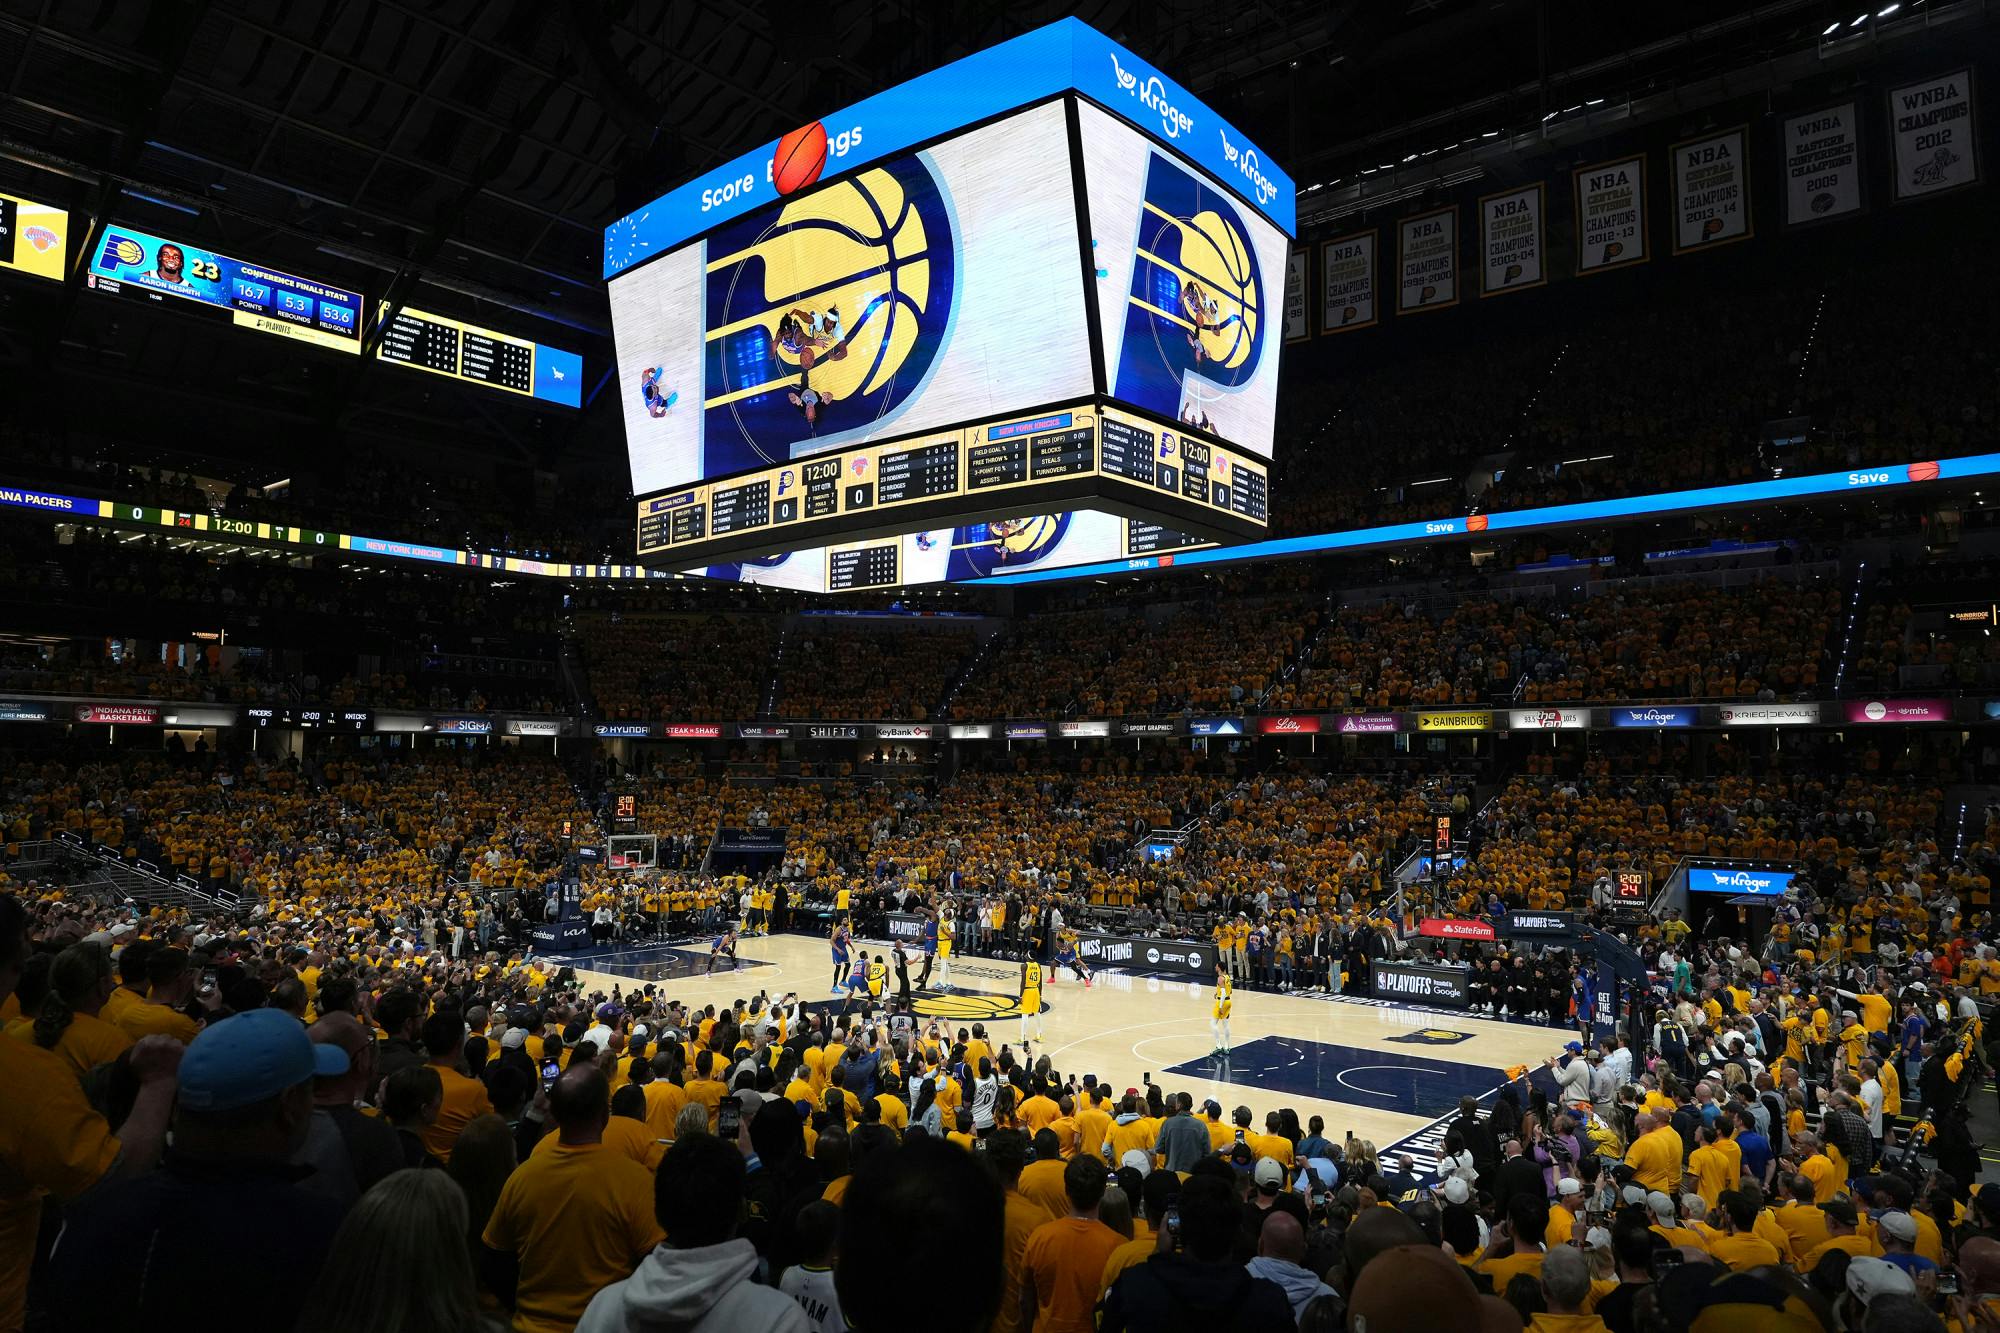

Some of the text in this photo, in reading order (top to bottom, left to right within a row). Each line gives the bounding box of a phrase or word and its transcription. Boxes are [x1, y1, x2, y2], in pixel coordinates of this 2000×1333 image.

[1902, 84, 1959, 111] WNBA
[1140, 77, 1194, 138] Kroger
[1898, 101, 1968, 133] CHAMPIONS
[1797, 116, 1841, 137] WNBA
[1796, 134, 1845, 155] EASTERN
[1916, 129, 1952, 151] 2012
[1688, 143, 1731, 168] NBA
[1788, 143, 1855, 167] CONFERENCE
[1686, 161, 1736, 182] CENTRAL
[1791, 154, 1852, 178] CHAMPIONS
[1240, 150, 1278, 206] Kroger
[1590, 170, 1630, 192] NBA
[1688, 171, 1734, 192] DIVISION
[1807, 174, 1839, 192] 2009
[701, 174, 754, 212] Score
[1587, 189, 1633, 205] CENTRAL
[1684, 185, 1738, 210] CHAMPIONS
[1494, 198, 1529, 220] NBA
[1589, 196, 1632, 216] DIVISION
[1490, 214, 1533, 231] CENTRAL
[1586, 210, 1636, 233] CHAMPIONS
[1413, 221, 1442, 240] NBA
[1490, 223, 1533, 241] DIVISION
[1489, 233, 1534, 256] CHAMPIONS
[1334, 244, 1363, 262] NBA
[190, 256, 220, 285] 23
[1405, 256, 1449, 279] CHAMPIONS
[139, 274, 201, 298] AARON NESMITH
[240, 265, 350, 303] CONFERENCE FINALS STATS
[1403, 270, 1453, 290] 1999-2000
[238, 282, 265, 302] 16.7
[1328, 278, 1370, 298] CHAMPIONS
[238, 299, 263, 312] POINTS
[285, 295, 306, 313] 5.3
[277, 309, 312, 325] REBOUNDS
[322, 306, 350, 325] 53.6
[265, 318, 292, 337] PLAYOFFS
[319, 320, 332, 330] FIELD
[332, 322, 347, 334] GOAL
[999, 417, 1061, 436] NEW YORK KNICKS
[974, 448, 988, 457] FIELD
[988, 447, 1002, 455] GOAL
[1040, 446, 1062, 455] BLOCKS
[1183, 440, 1209, 464] 12:00
[972, 458, 985, 467] FREE
[985, 455, 1003, 465] THROW
[1041, 456, 1061, 465] STEALS
[806, 461, 838, 483] 12:00
[880, 463, 909, 474] 11 BRUNSON
[1035, 465, 1067, 476] TURNOVERS
[879, 472, 911, 484] 23 ROBINSON
[979, 475, 1001, 485] ASSISTS
[1164, 470, 1171, 486] 0
[1848, 470, 1890, 486] Save
[811, 482, 832, 494] 1ST QTR
[879, 482, 907, 493] 25 BRIDGES
[24, 493, 73, 509] PACERS
[855, 488, 864, 504] 0
[879, 492, 904, 502] 32 TOWNS
[1218, 491, 1225, 504] 0
[132, 506, 143, 520] 0
[782, 503, 790, 518] 0
[177, 517, 191, 529] 24
[213, 517, 253, 535] 12:00
[1425, 521, 1454, 535] Save
[315, 531, 325, 545] 0
[365, 540, 444, 560] NEW YORK KNICKS
[1128, 558, 1150, 569] Save
[95, 707, 158, 716] INDIANA FEVER
[99, 713, 153, 722] BASKETBALL
[248, 709, 273, 718] PACERS
[344, 713, 367, 721] KNICKS
[1537, 709, 1556, 720] the
[1643, 708, 1676, 726] Kroger
[1909, 706, 1930, 715] mhs
[260, 718, 267, 726] 0
[355, 721, 362, 729] 0
[533, 723, 558, 731] ACADEMY
[1275, 717, 1302, 733] Lilly
[1358, 715, 1393, 724] Ascension
[1369, 723, 1395, 731] Vincent
[1432, 714, 1489, 727] GAINBRIDGE
[609, 727, 652, 735] HYUNDAI
[665, 727, 686, 735] STEAK
[695, 727, 720, 735] SHAKE
[810, 727, 847, 737] SHIFT
[876, 728, 912, 739] KeyBank
[1129, 724, 1175, 732] SPORT GRAPHICS
[618, 796, 635, 804] 12:00
[617, 803, 634, 817] 24
[1437, 829, 1449, 849] 24
[1620, 873, 1642, 885] 12:00
[1730, 871, 1771, 893] Kroger
[1620, 884, 1638, 896] 24
[563, 912, 583, 920] Google
[1518, 916, 1547, 928] PLAYOFFS
[894, 919, 922, 937] PLAYOFFS
[1547, 921, 1566, 930] Google
[532, 930, 556, 941] coinbase
[1080, 939, 1133, 962] MISS A THING
[1147, 952, 1202, 966] abc ESPN TNT
[1028, 971, 1039, 983] 43
[1386, 972, 1432, 995] PLAYOFFS
[1433, 985, 1461, 999] Google
[1598, 991, 1611, 1003] GET
[1407, 1004, 1494, 1019] Google
[1599, 1002, 1611, 1014] THE
[1601, 1013, 1614, 1027] App
[983, 1092, 991, 1106] 0
